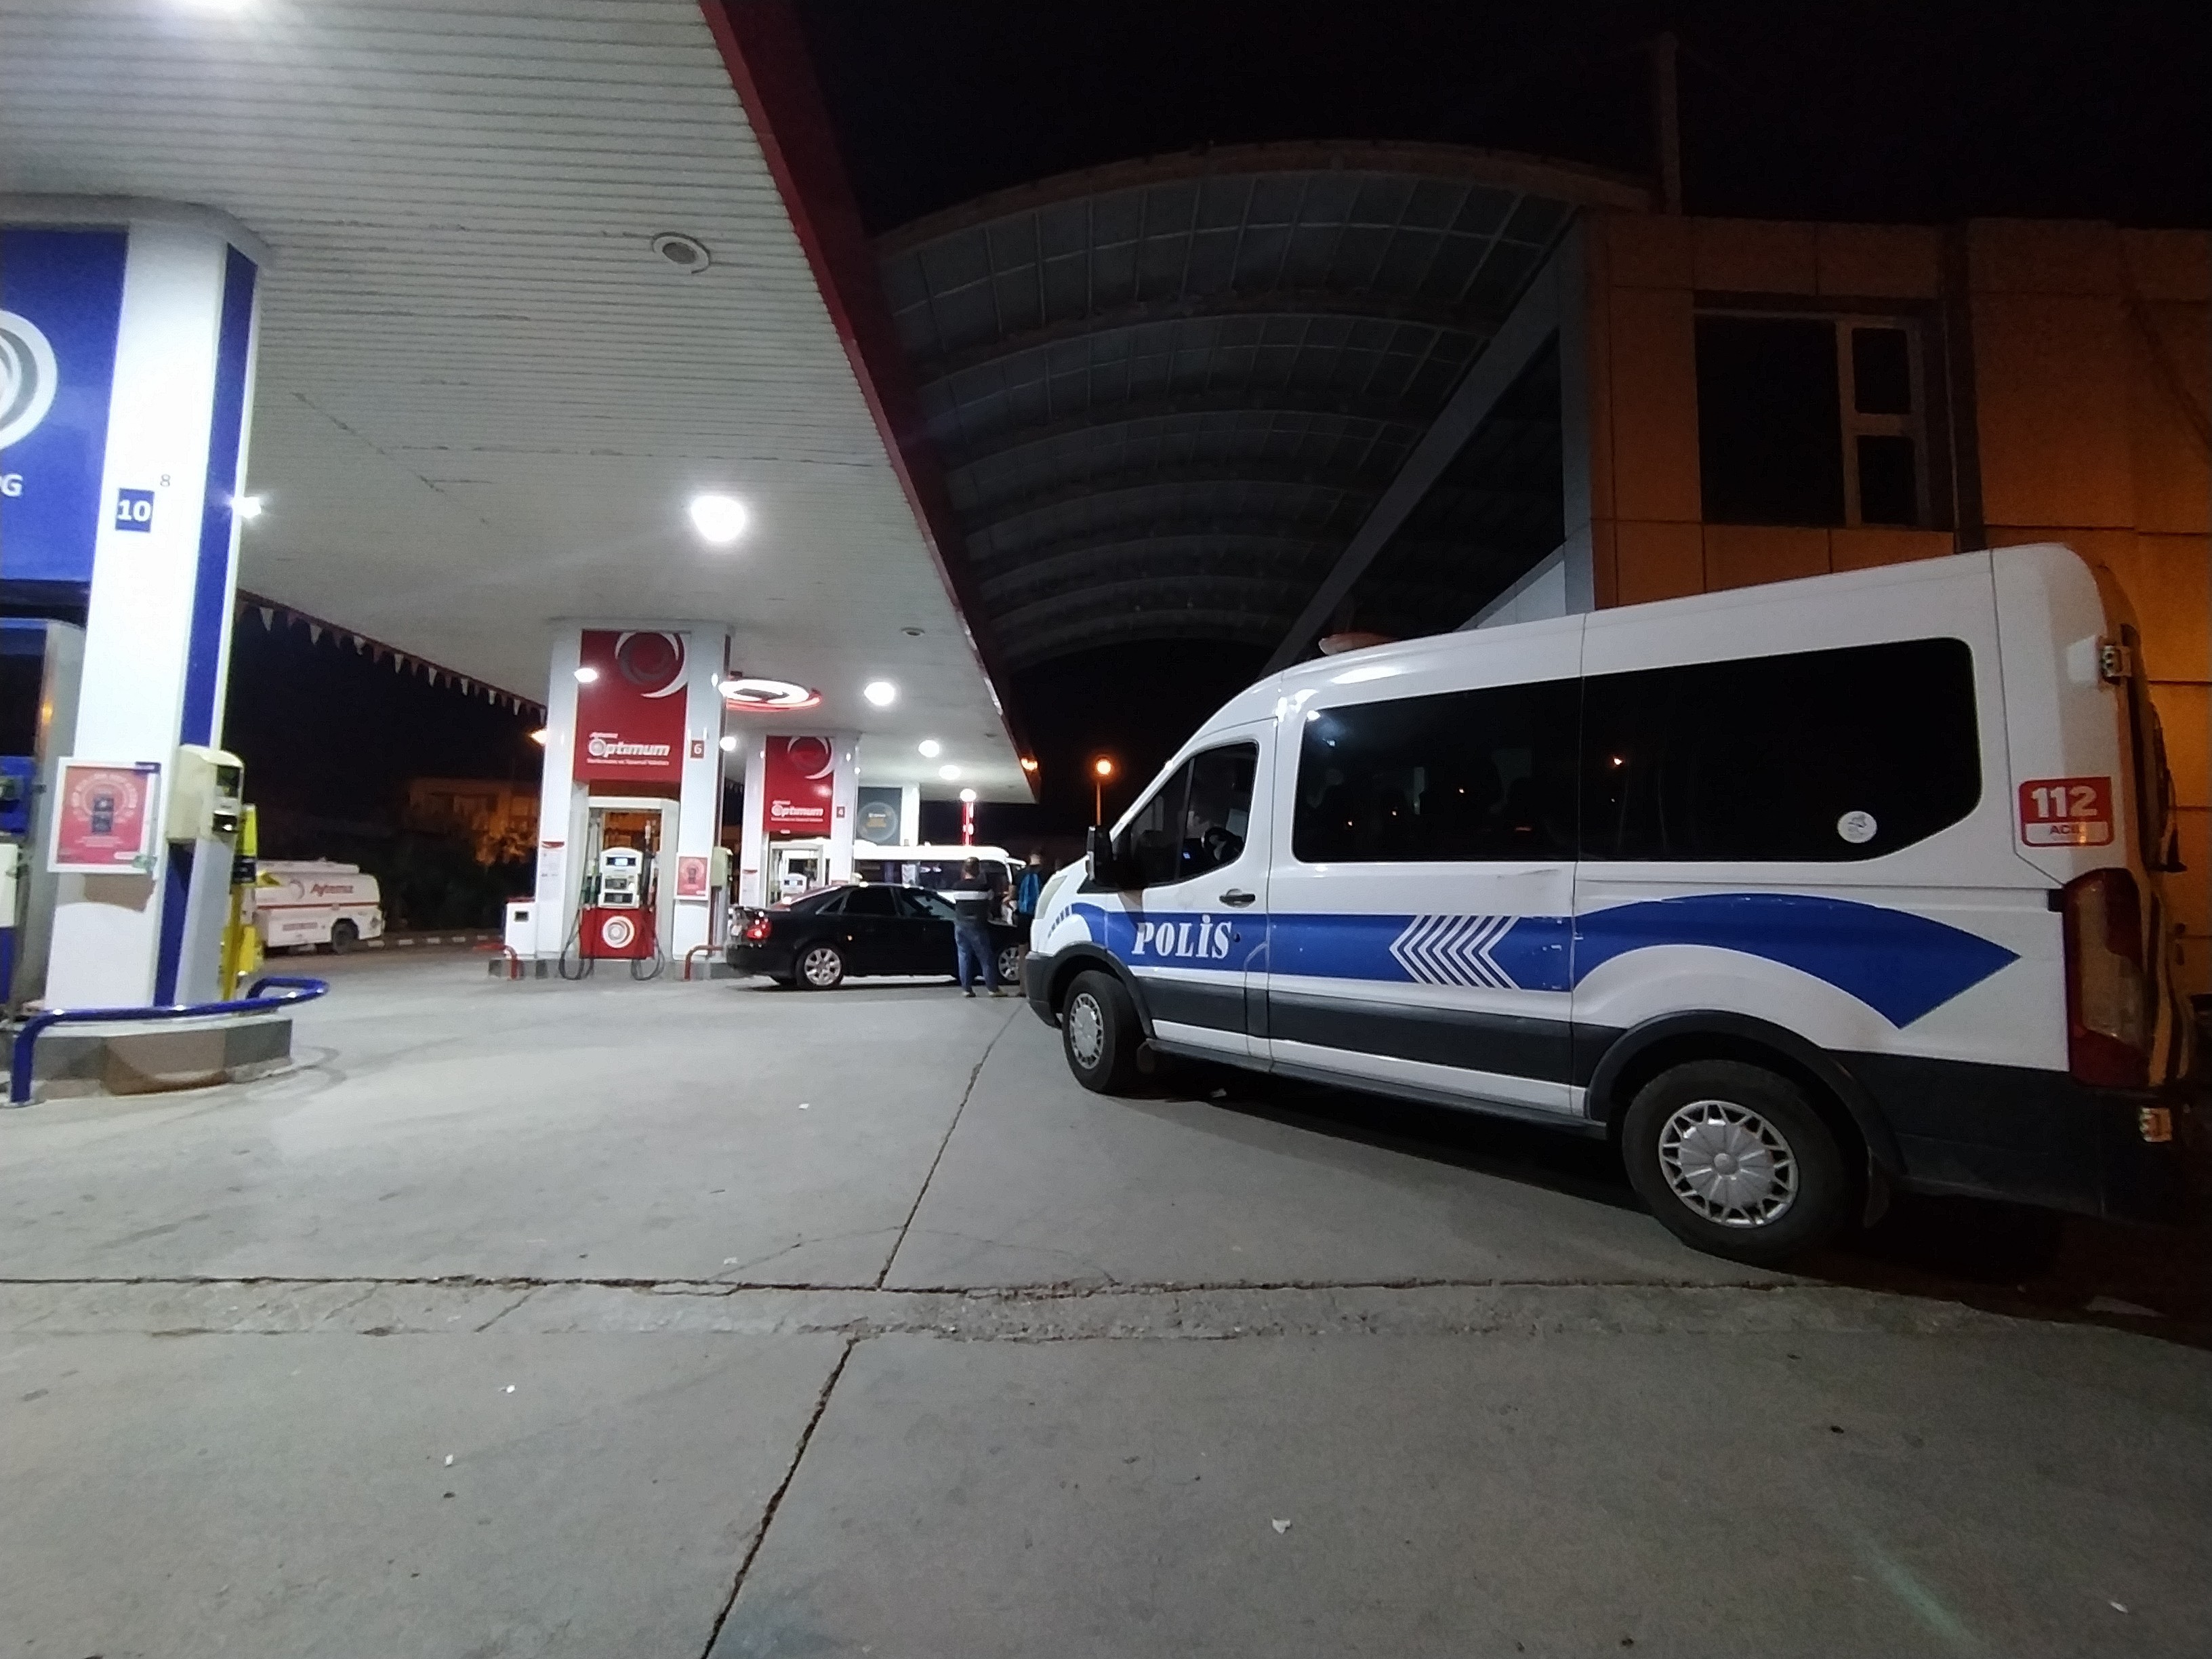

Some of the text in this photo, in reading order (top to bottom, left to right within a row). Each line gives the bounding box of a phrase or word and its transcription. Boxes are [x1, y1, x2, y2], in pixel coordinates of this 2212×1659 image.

[0, 474, 24, 497] G
[160, 474, 171, 487] 8
[117, 499, 151, 521] 10
[693, 743, 702, 754] 6
[2031, 785, 2098, 818] 112
[1131, 914, 1232, 959] POLİS
